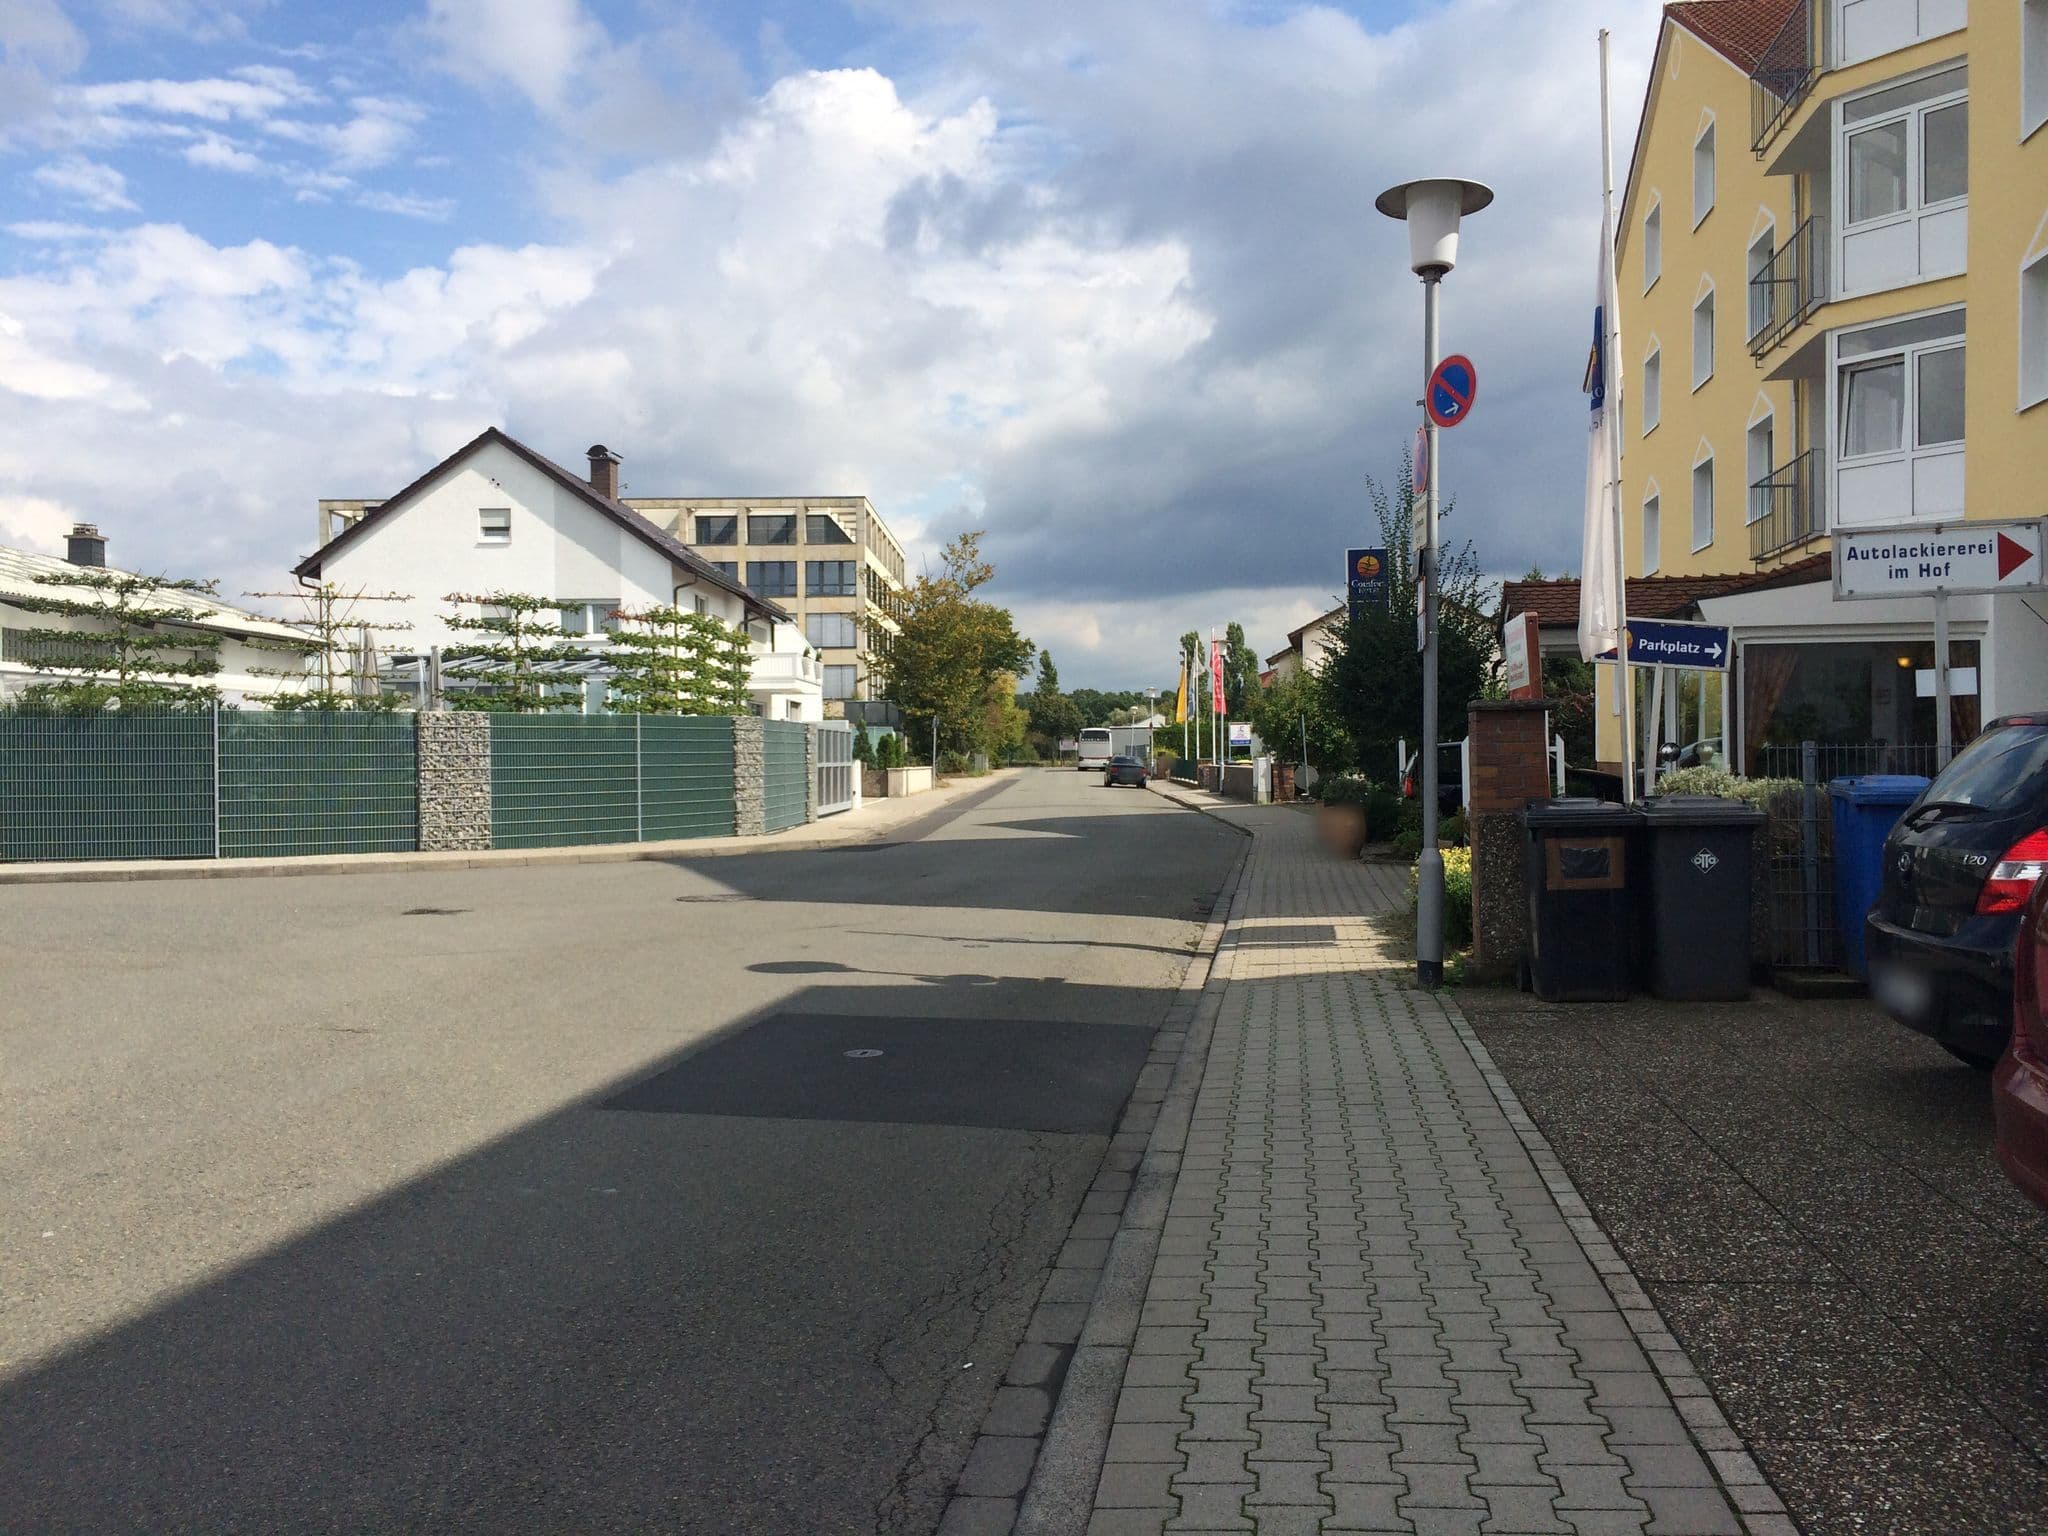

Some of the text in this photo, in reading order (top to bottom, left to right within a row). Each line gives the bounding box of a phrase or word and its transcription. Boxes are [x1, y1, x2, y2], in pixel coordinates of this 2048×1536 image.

[1847, 539, 1993, 561] Autolackiererei
[1888, 562, 1951, 579] im Hof
[1639, 638, 1700, 655] Parkplatz
[1963, 853, 1987, 866] i20
